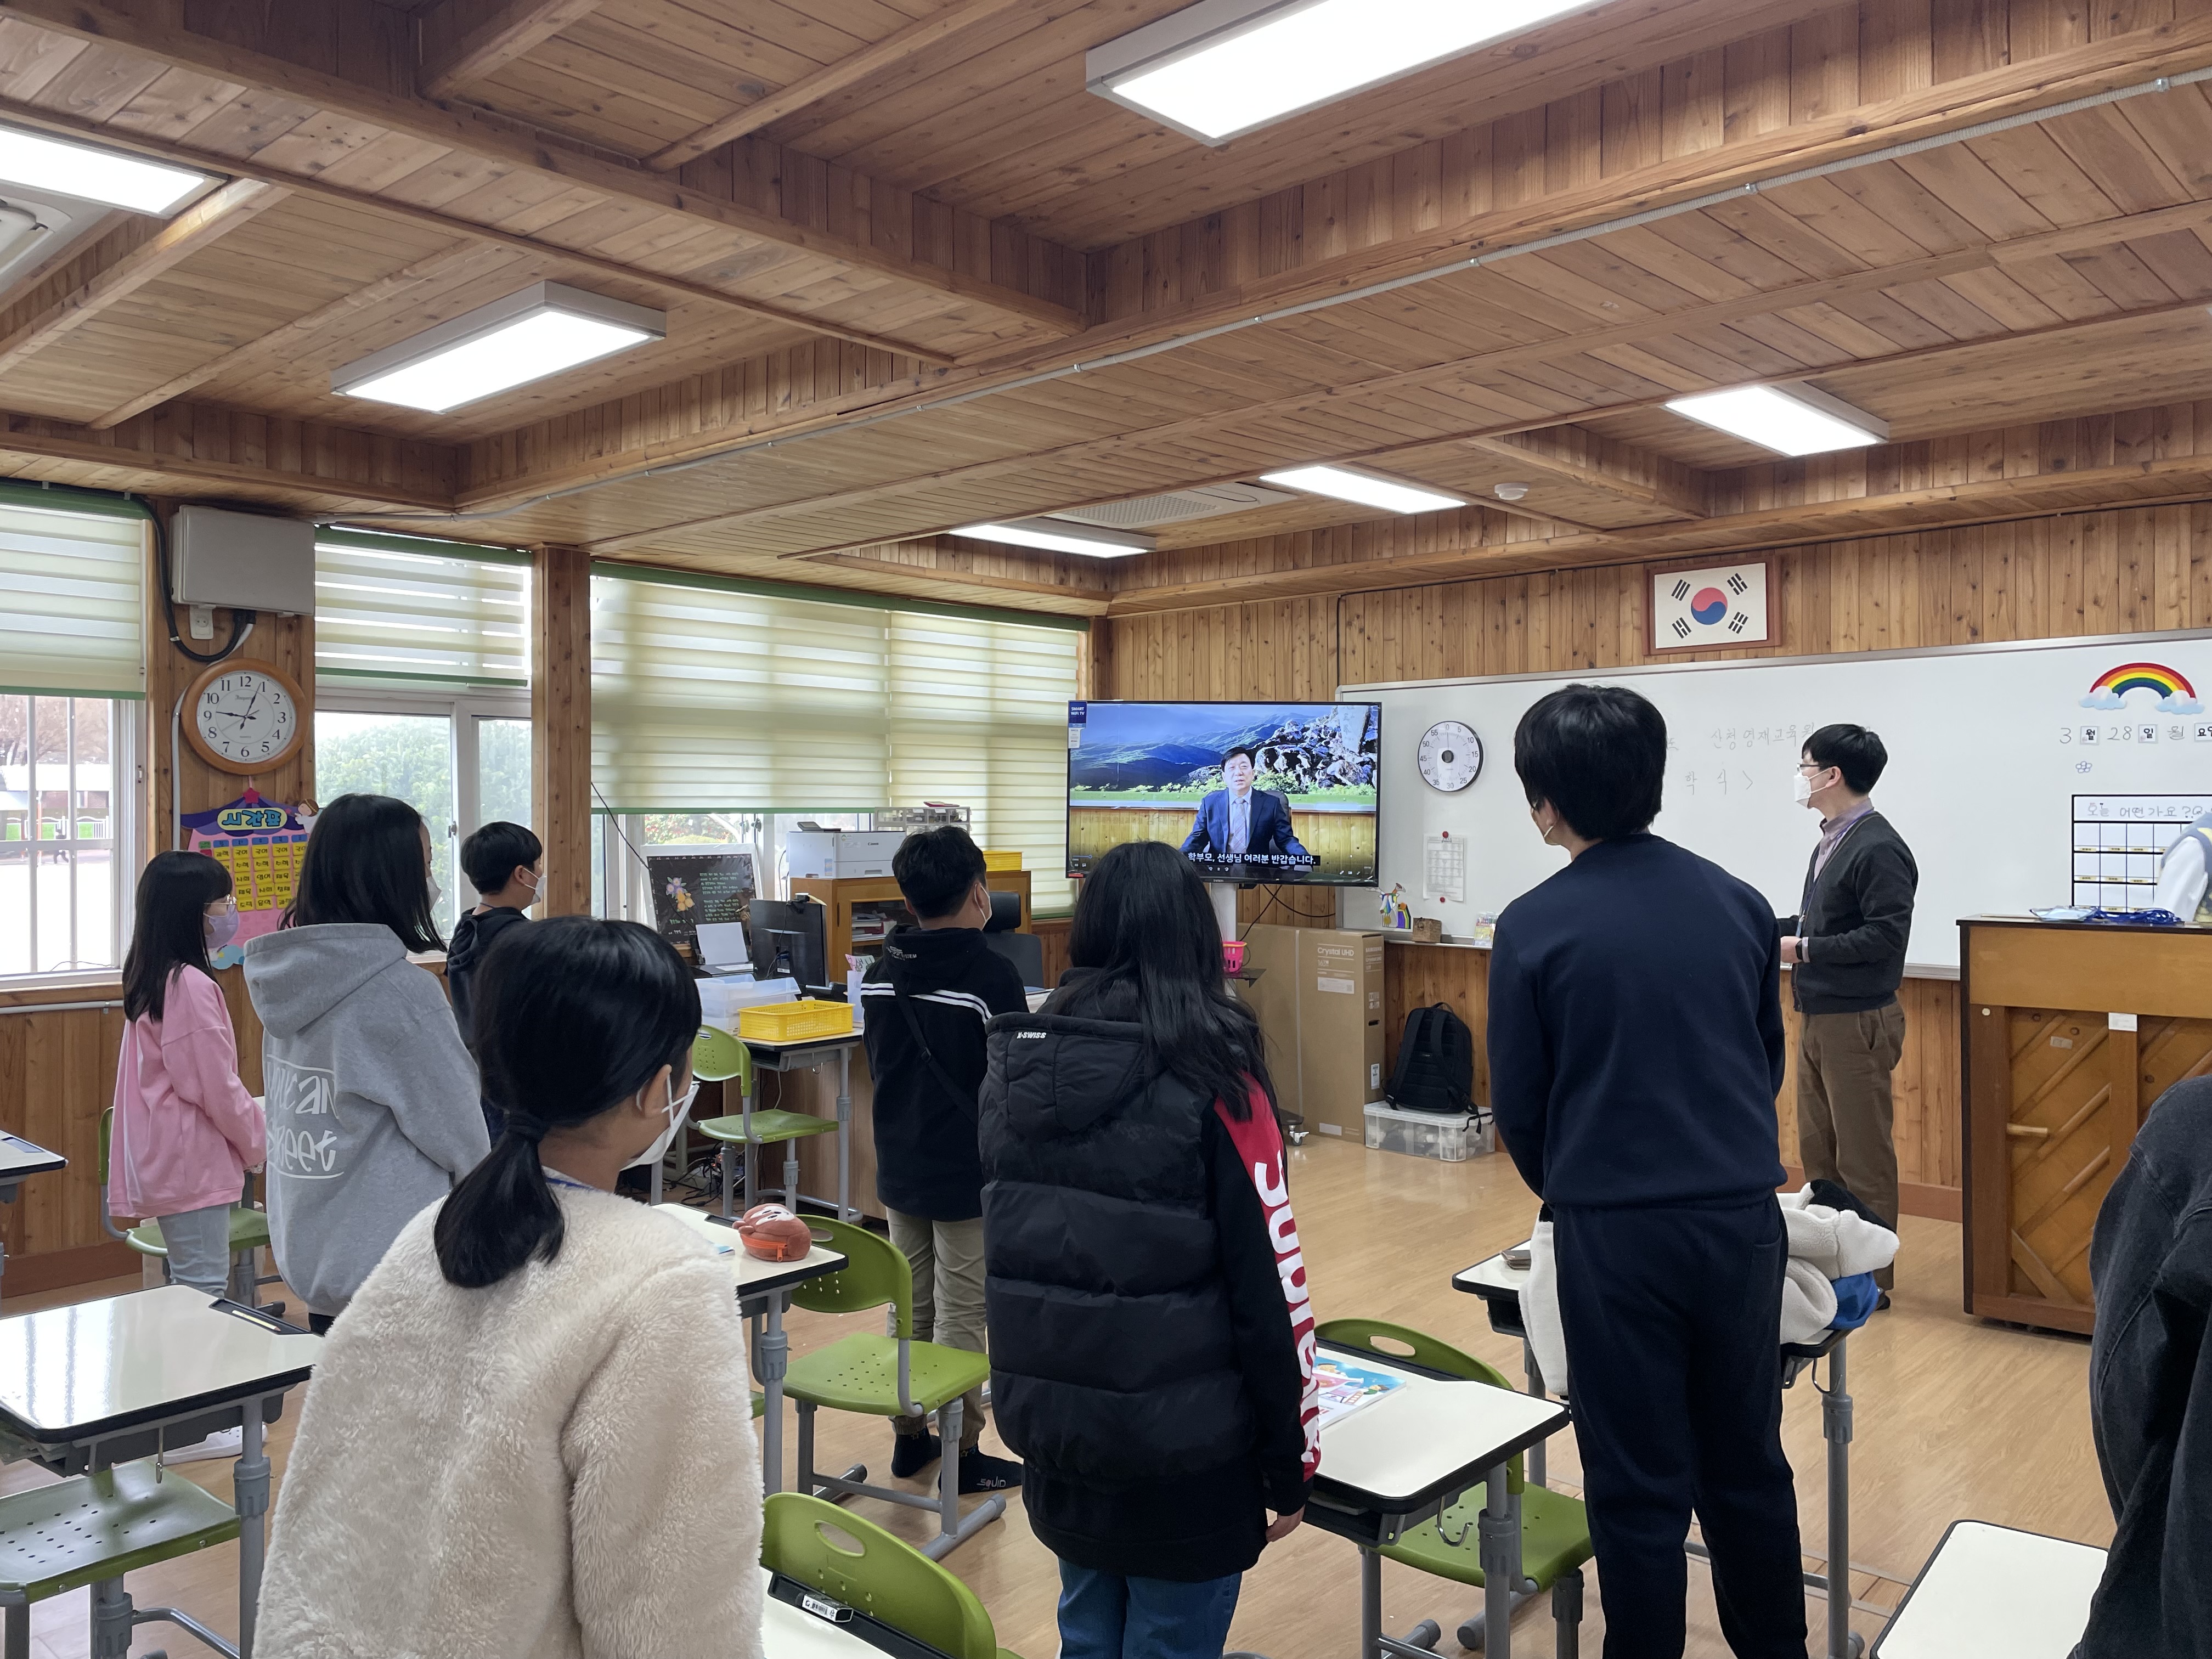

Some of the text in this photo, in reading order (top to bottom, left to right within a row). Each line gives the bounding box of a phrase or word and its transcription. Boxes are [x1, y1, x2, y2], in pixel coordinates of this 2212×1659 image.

[221, 680, 230, 691] 11
[240, 676, 251, 687] 12
[262, 681, 266, 692] 1
[207, 693, 219, 704] 10
[273, 693, 280, 704] 2
[204, 710, 212, 721] 9
[277, 712, 286, 723] 3
[208, 727, 217, 738] 8
[272, 729, 280, 740] 4
[2059, 727, 2072, 744] 3
[2086, 729, 2095, 741] 월
[2107, 726, 2132, 741] 28
[2143, 727, 2154, 738] 일
[222, 741, 230, 753] 7
[241, 746, 250, 757] 6
[261, 741, 269, 752] 5
[222, 809, 282, 827] 시간표
[1188, 852, 1316, 865] 학부모, 선생님 여러분 반갑습니다.
[1317, 947, 1355, 957] Crystal UHD
